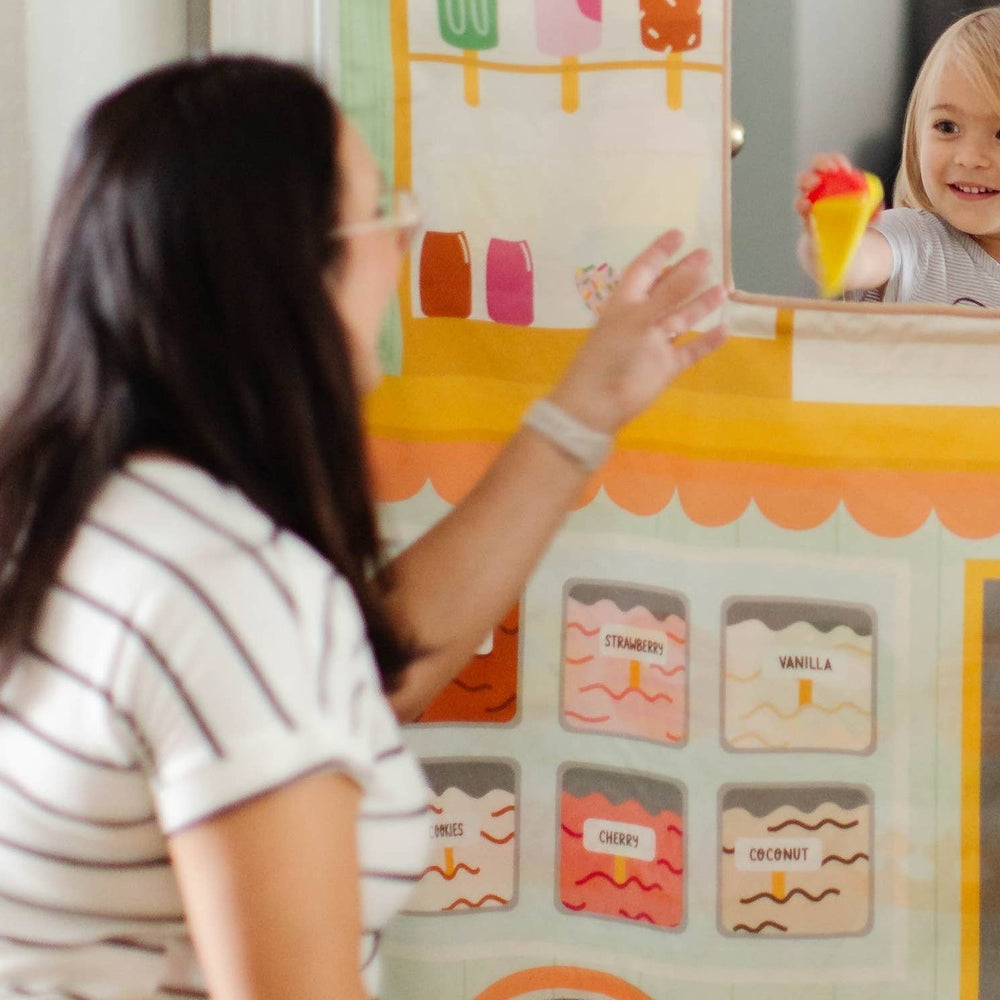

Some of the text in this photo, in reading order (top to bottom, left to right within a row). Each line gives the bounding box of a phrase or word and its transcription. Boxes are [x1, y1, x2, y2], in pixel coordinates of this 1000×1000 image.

[604, 633, 665, 656] STRAWBERRY
[779, 655, 833, 671] VANILLA
[598, 829, 639, 848] CHERRY
[749, 847, 809, 862] COCONUT
